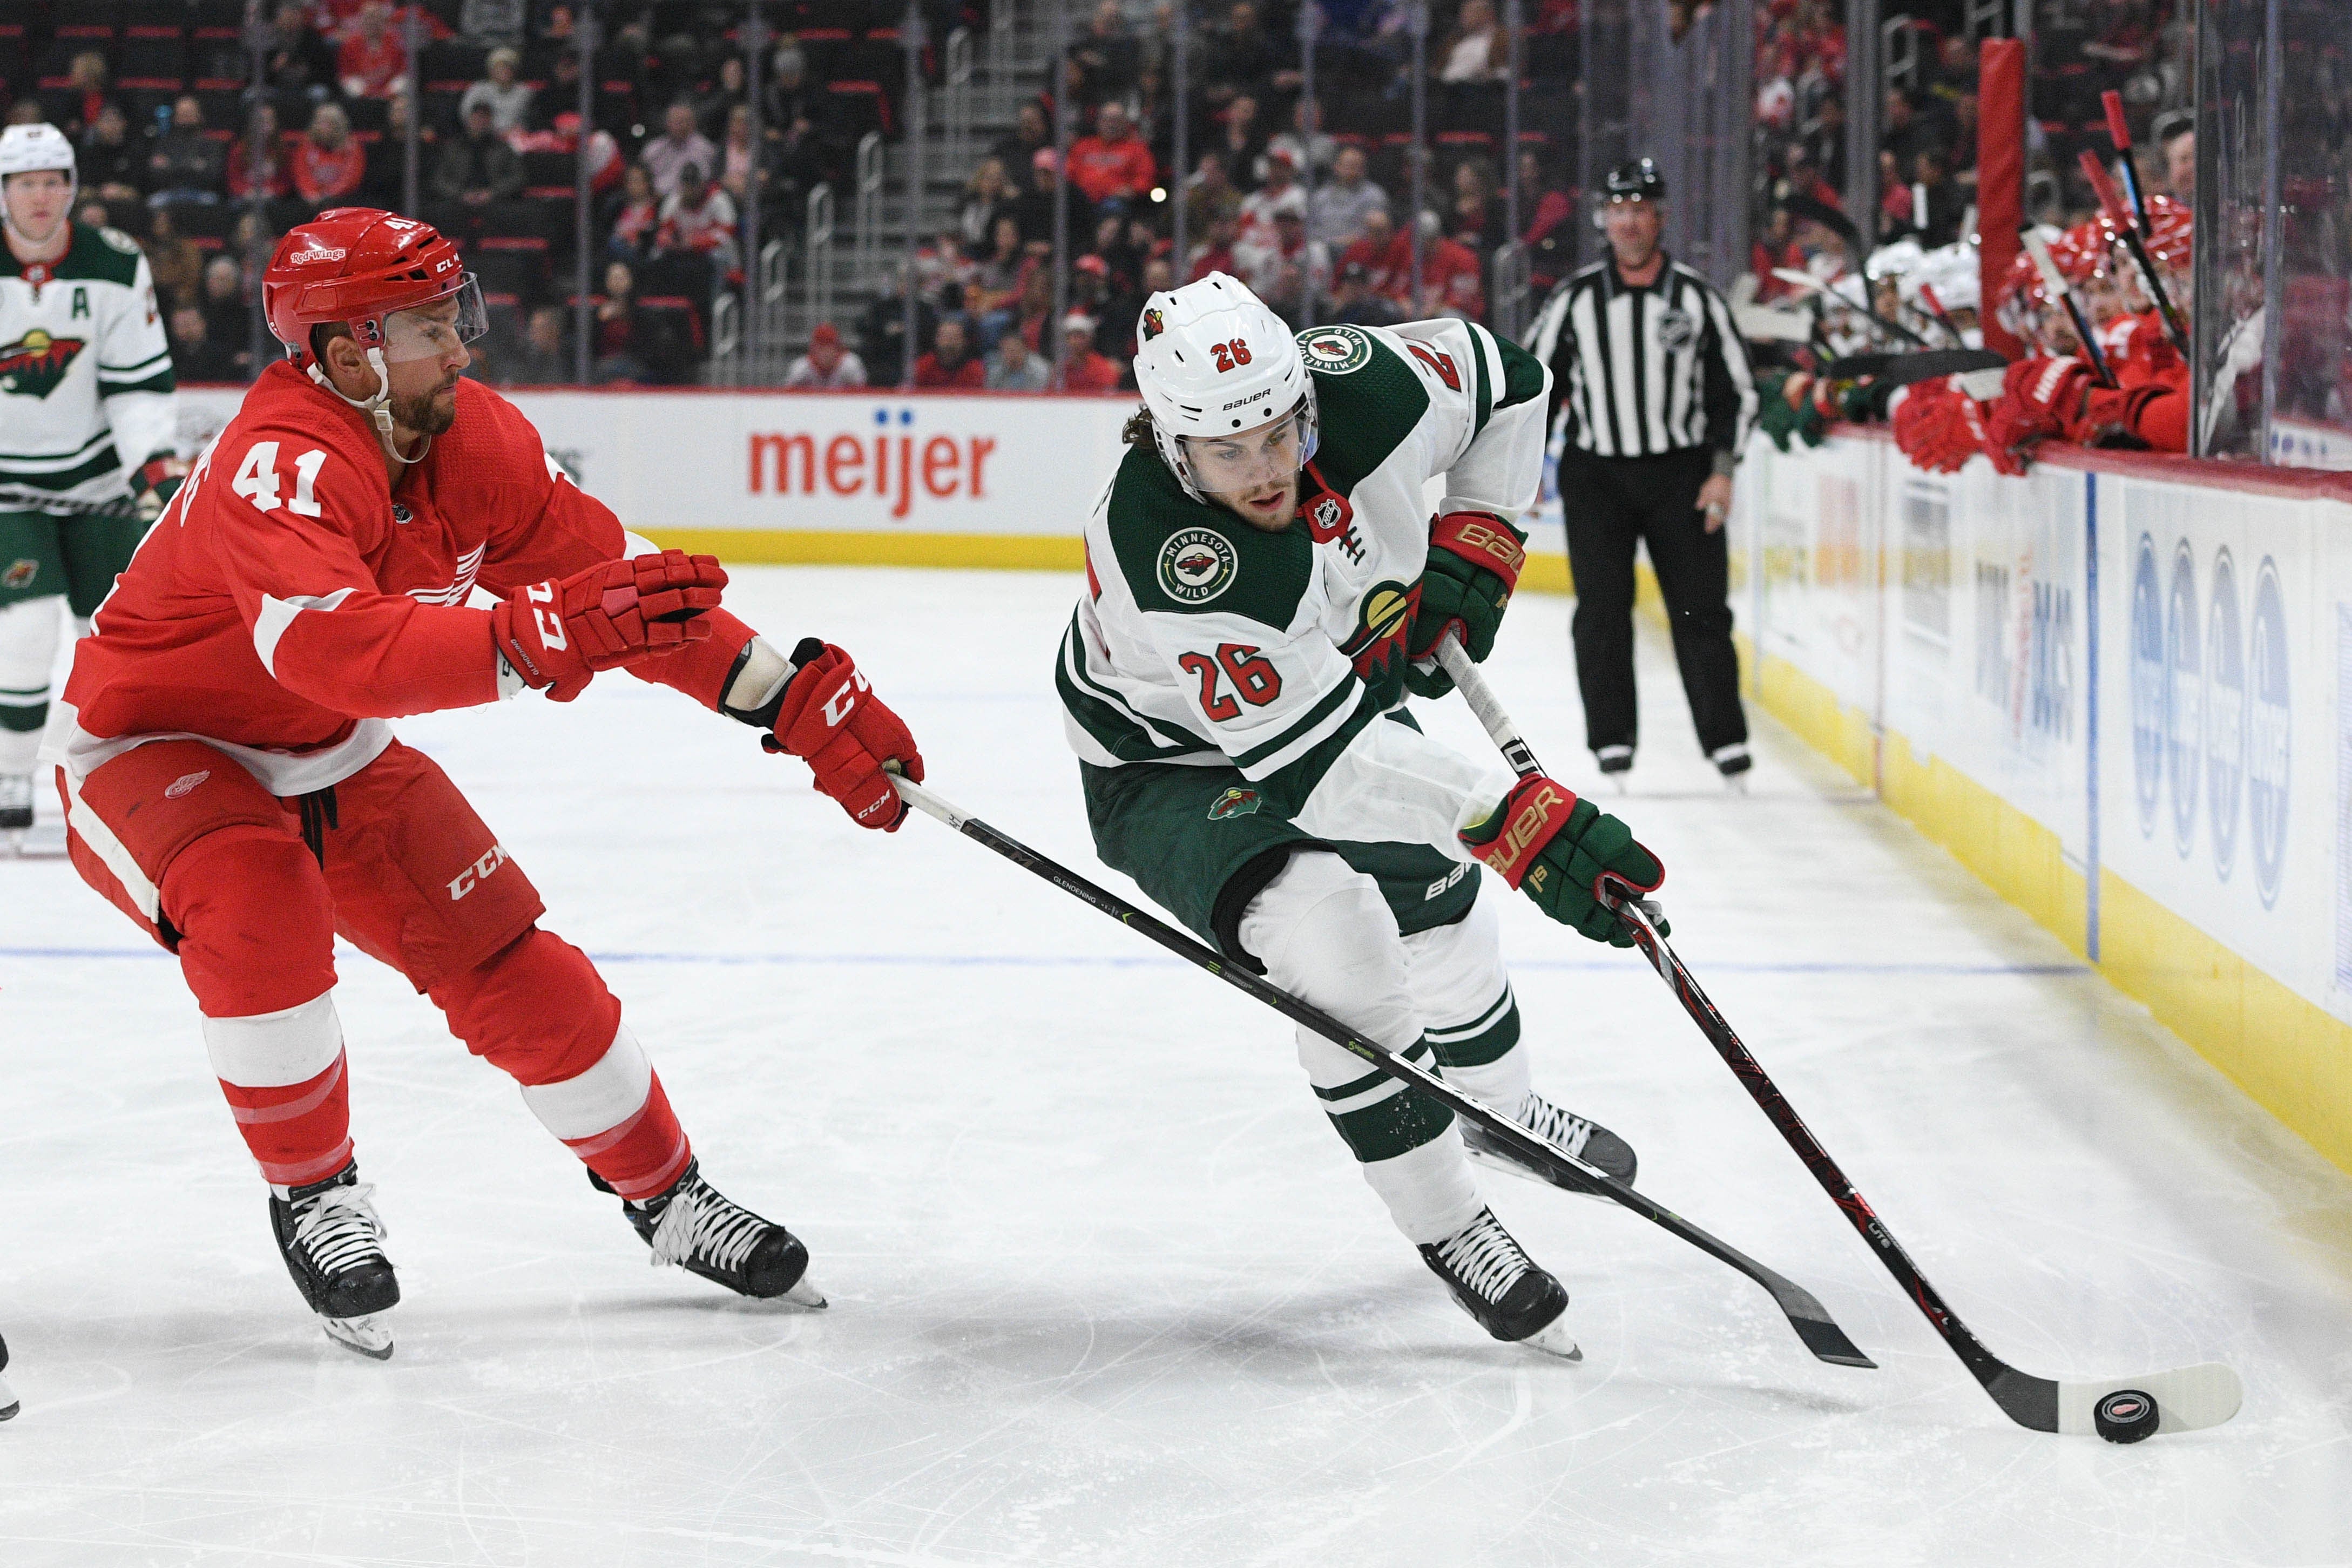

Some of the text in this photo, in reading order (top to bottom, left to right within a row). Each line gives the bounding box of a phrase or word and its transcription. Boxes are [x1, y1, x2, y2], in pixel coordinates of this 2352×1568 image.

[291, 247, 346, 264] Red Wings
[72, 287, 91, 320] A
[1334, 328, 1363, 347] WILD
[1210, 337, 1253, 374] 26
[1222, 388, 1271, 411] BAUER
[232, 441, 327, 517] 41
[748, 408, 996, 519] meijer
[1166, 533, 1231, 563] MINNESOTA
[1175, 583, 1209, 598] WILD
[510, 638, 540, 676] GLENDENING
[1178, 641, 1283, 722] 26
[857, 789, 891, 819] CCM
[445, 844, 509, 901] CCM
[1053, 875, 1097, 904] GLENDENING
